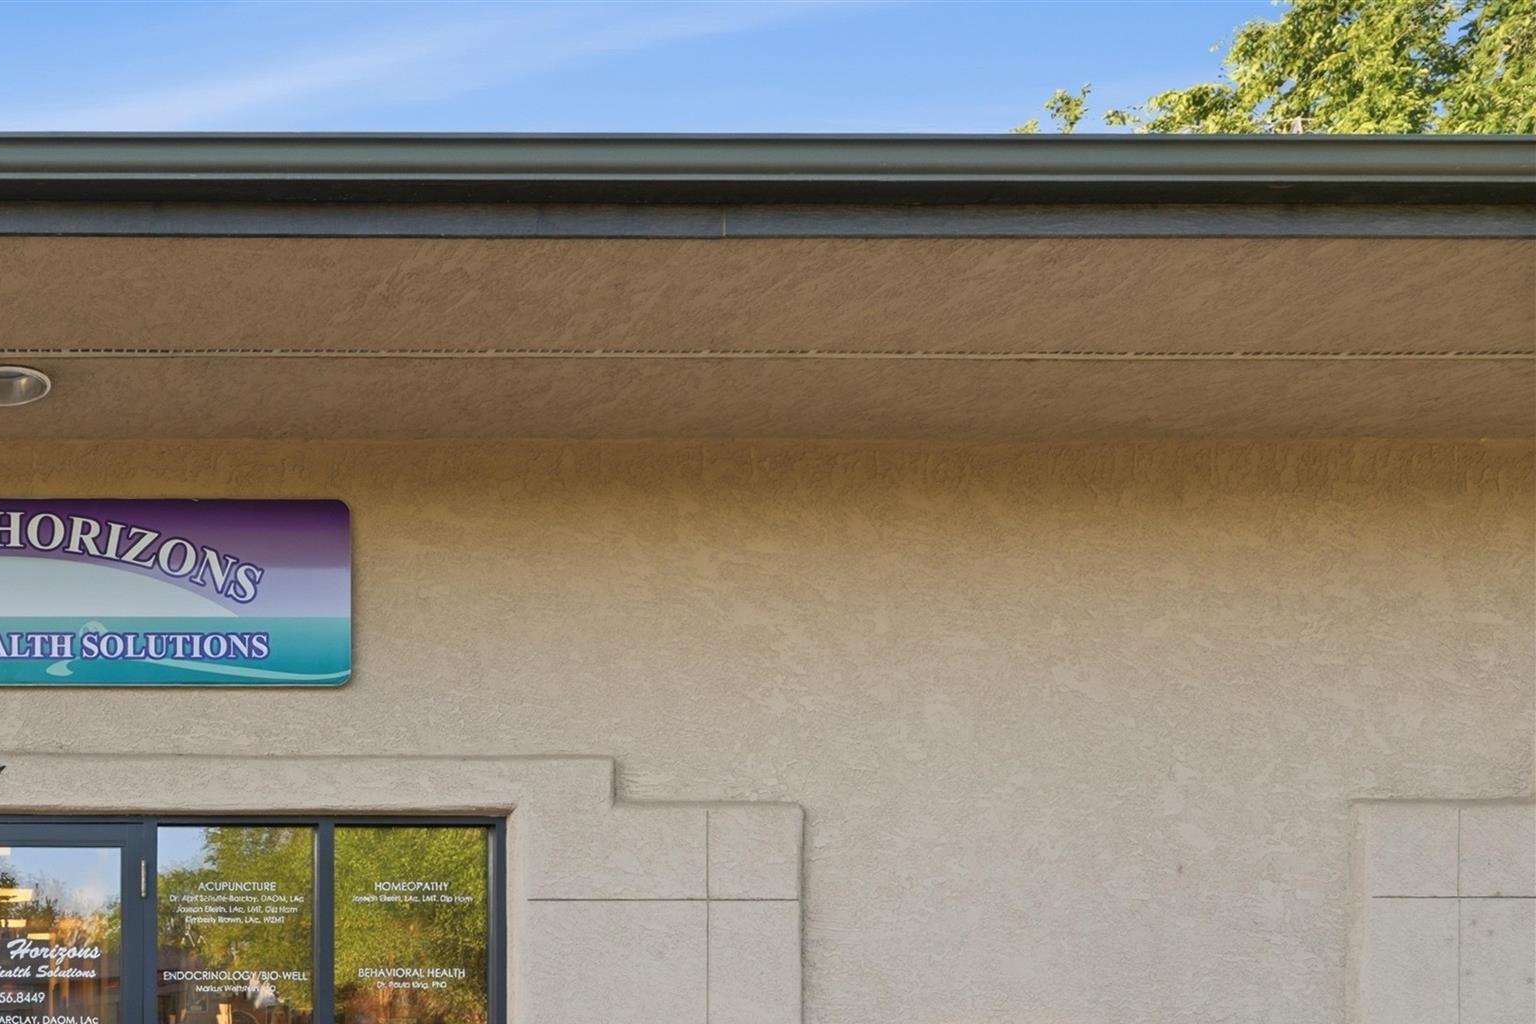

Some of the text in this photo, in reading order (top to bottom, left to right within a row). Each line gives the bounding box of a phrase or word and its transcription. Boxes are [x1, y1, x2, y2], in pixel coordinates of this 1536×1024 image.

[81, 632, 270, 660] SOLUTIONS
[198, 882, 276, 891] ACUPUNCTURE
[375, 882, 448, 891] HOMEOPATHY
[290, 895, 304, 903] LAc
[7, 938, 100, 965] Horizons
[36, 965, 96, 981] Solutions
[358, 968, 466, 978] BEHAVIORAL HEALTH
[43, 1016, 78, 1024] DAOM,
[80, 1016, 99, 1024] LAc
